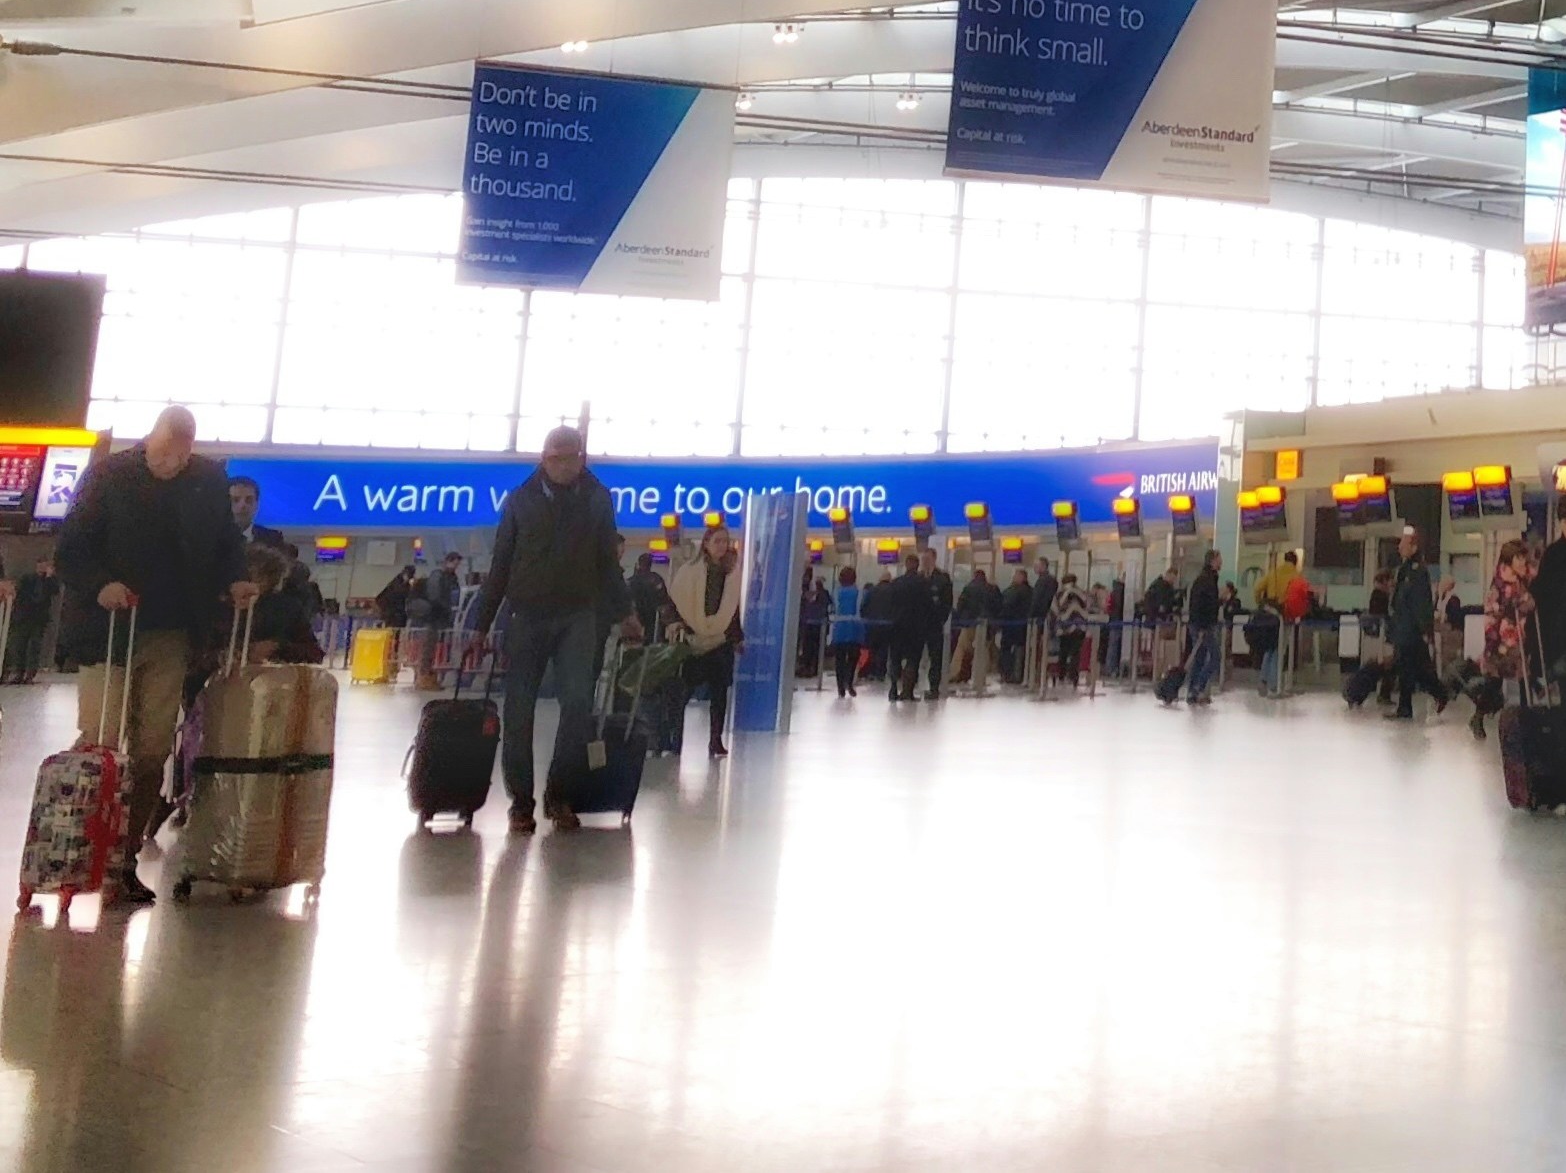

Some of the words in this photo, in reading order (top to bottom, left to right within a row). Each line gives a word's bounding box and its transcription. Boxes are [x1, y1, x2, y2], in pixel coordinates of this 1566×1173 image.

[1119, 5, 1144, 31] to
[965, 24, 1029, 57] think
[1037, 38, 1108, 66] small.
[479, 81, 537, 108] Don't
[544, 85, 571, 110] be
[579, 92, 597, 113] in
[959, 97, 987, 108] asset
[961, 81, 1006, 96] Welcome
[1009, 87, 1020, 97] to
[1022, 88, 1045, 102] truly
[1046, 90, 1077, 103] global
[476, 114, 517, 136] two
[524, 119, 593, 143] minds.
[957, 128, 991, 142] Capital
[993, 132, 1004, 141] at
[474, 142, 502, 165] Be
[509, 146, 528, 167] in
[536, 151, 549, 170] a
[471, 173, 577, 202] thousand.
[313, 474, 347, 511] A
[364, 484, 474, 512] warm
[674, 483, 709, 514] to
[1140, 472, 1186, 494] BRITISH
